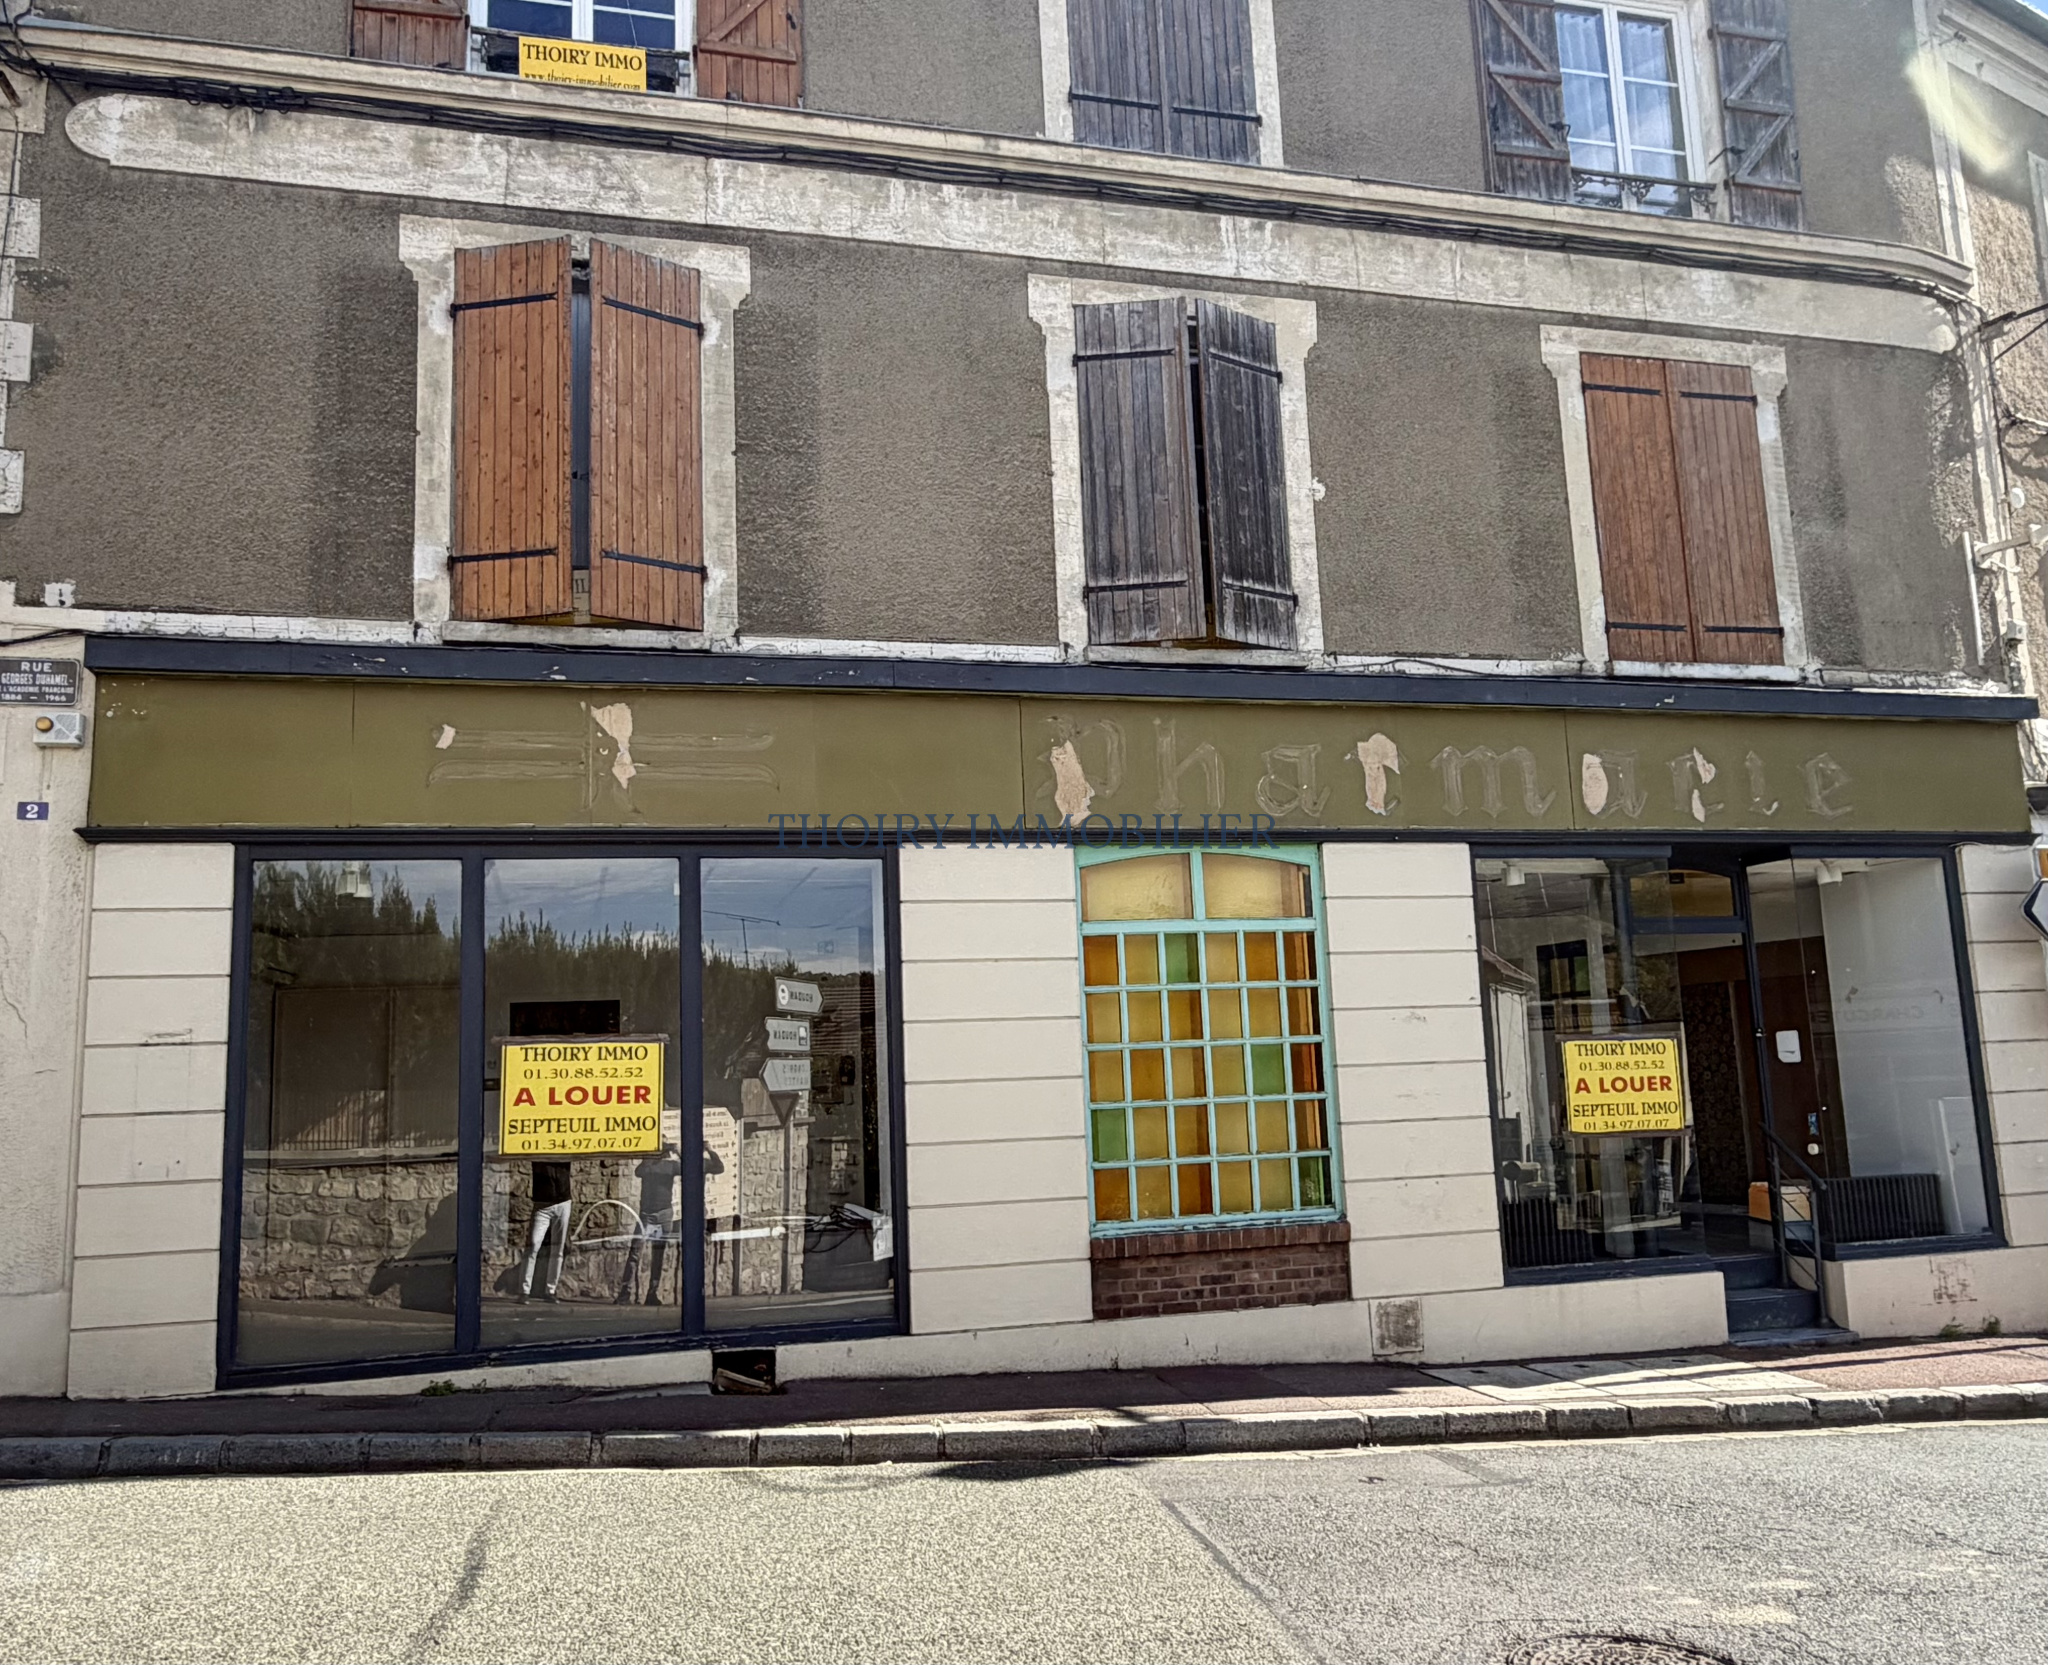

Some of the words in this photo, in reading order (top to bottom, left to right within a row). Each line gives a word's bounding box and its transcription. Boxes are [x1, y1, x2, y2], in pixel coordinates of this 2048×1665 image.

[523, 43, 590, 65] THOIRY
[595, 51, 642, 71] IMMO
[21, 661, 52, 672] RUE
[25, 804, 39, 819] 2
[520, 1046, 593, 1062] THOIRY
[597, 1045, 648, 1061] IMMO
[1574, 1042, 1626, 1057] THOIRY
[1629, 1042, 1666, 1056] IMMO
[1579, 1060, 1665, 1071] 01.30.88.52.52
[523, 1067, 643, 1080] 01.30.88.52.52
[1574, 1077, 1591, 1094] A
[1598, 1075, 1672, 1093] LOUER
[513, 1087, 536, 1106] A
[548, 1085, 651, 1106] LOUER
[1573, 1102, 1639, 1117] SEPTEUIL
[1641, 1101, 1678, 1115] IMMO
[508, 1117, 600, 1135] SEPTEUIL
[605, 1116, 656, 1132] IMMO
[1583, 1119, 1669, 1131] 01.34.97.07.07
[521, 1136, 642, 1150] 01.34.97.07.07
